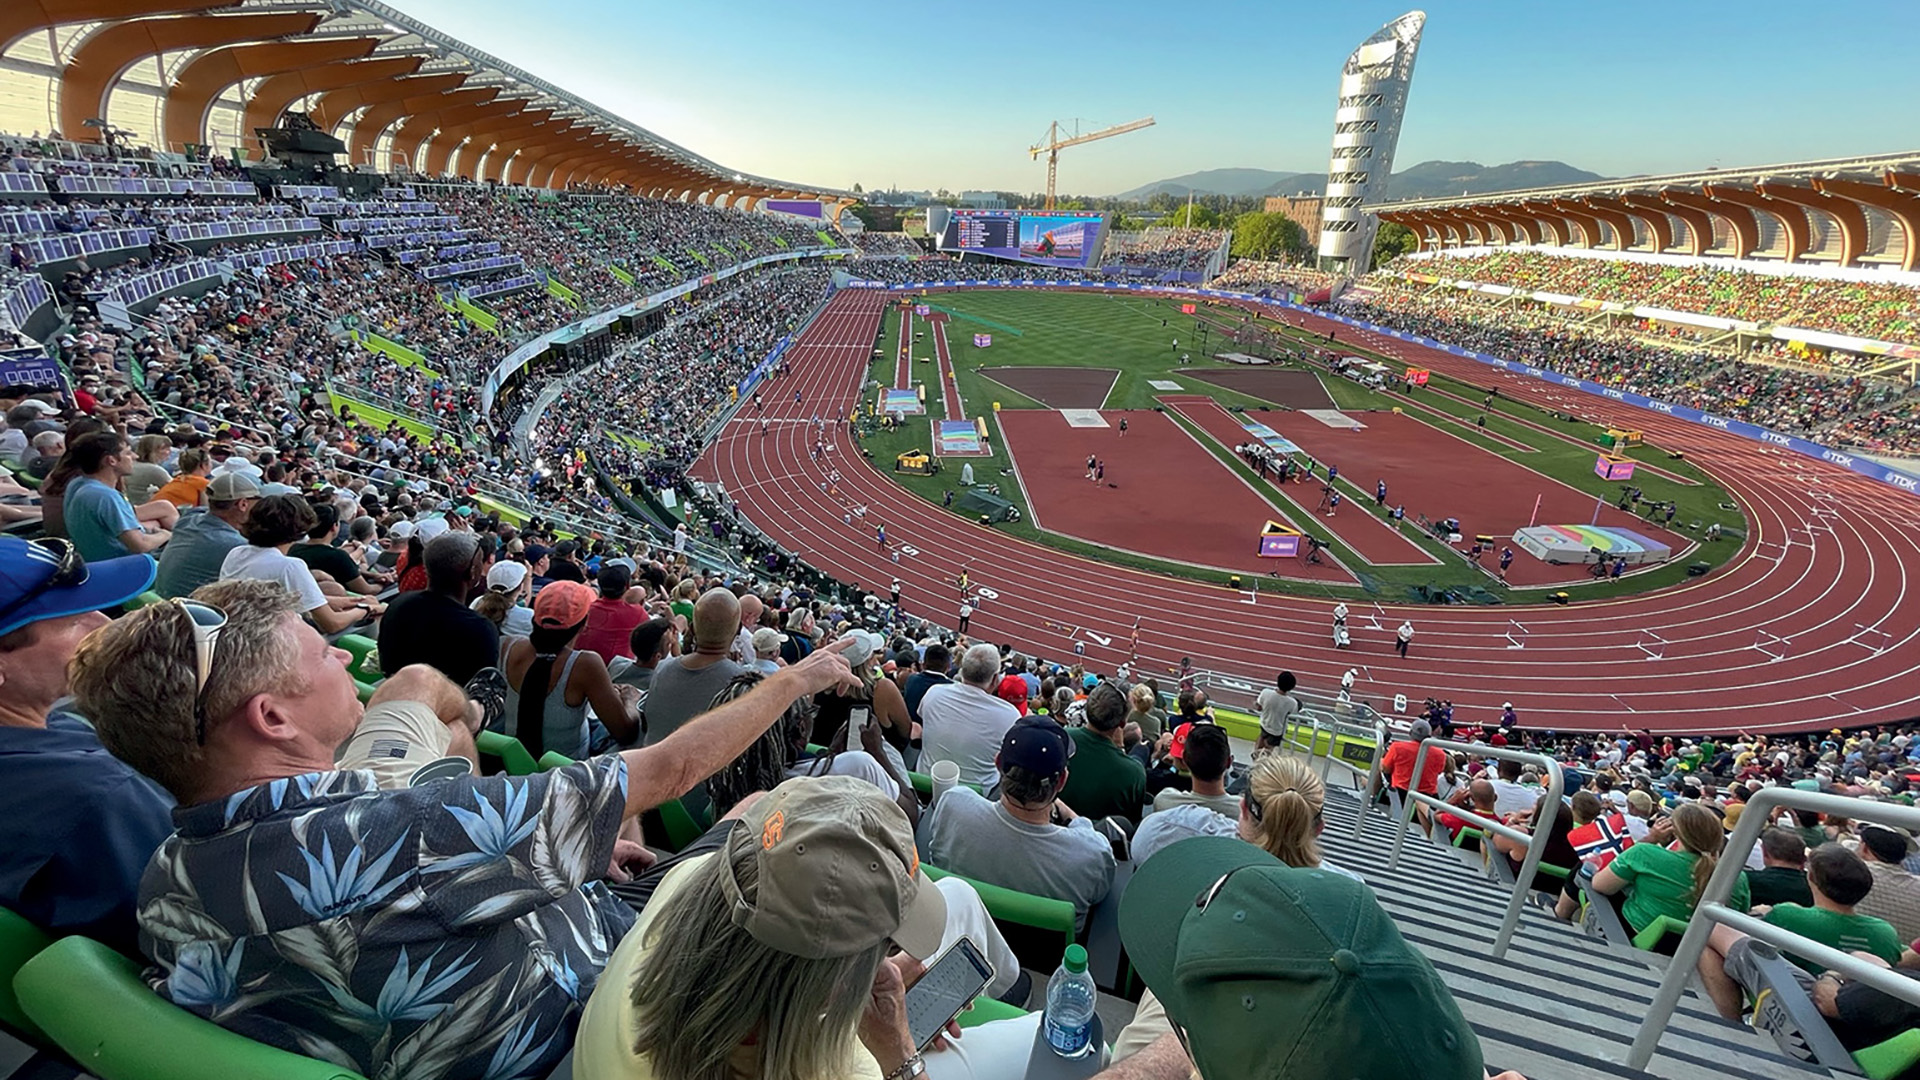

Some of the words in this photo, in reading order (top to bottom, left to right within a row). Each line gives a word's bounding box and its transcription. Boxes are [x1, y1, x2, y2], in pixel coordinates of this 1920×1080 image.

[1567, 378, 1581, 388] TDK
[1608, 389, 1623, 399] TDK
[1654, 402, 1672, 413] TDK
[1706, 416, 1729, 429] TDK
[1769, 434, 1790, 446] TDK
[1830, 453, 1854, 466] TDK
[1893, 475, 1917, 490] TDK
[1085, 630, 1112, 646] 7
[1350, 747, 1369, 758] 216
